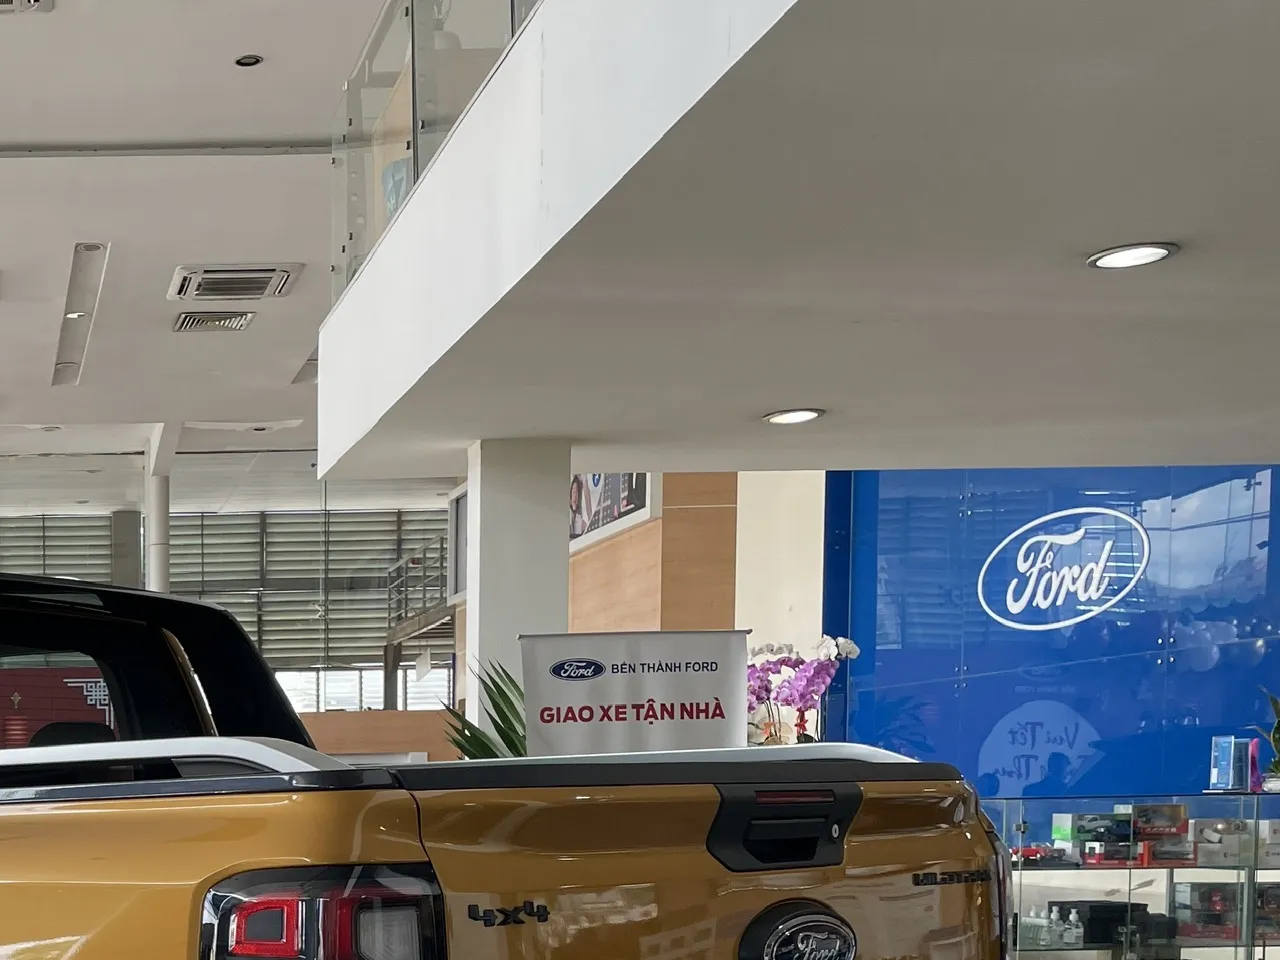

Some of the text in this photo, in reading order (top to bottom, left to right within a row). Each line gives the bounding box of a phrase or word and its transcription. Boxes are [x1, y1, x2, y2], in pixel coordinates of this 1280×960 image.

[1006, 528, 1115, 615] Ford
[560, 661, 595, 677] Ford
[640, 660, 682, 673] THÀNH
[685, 661, 718, 673] FORD
[539, 696, 726, 725] GIAO XE TẬN NHÀ
